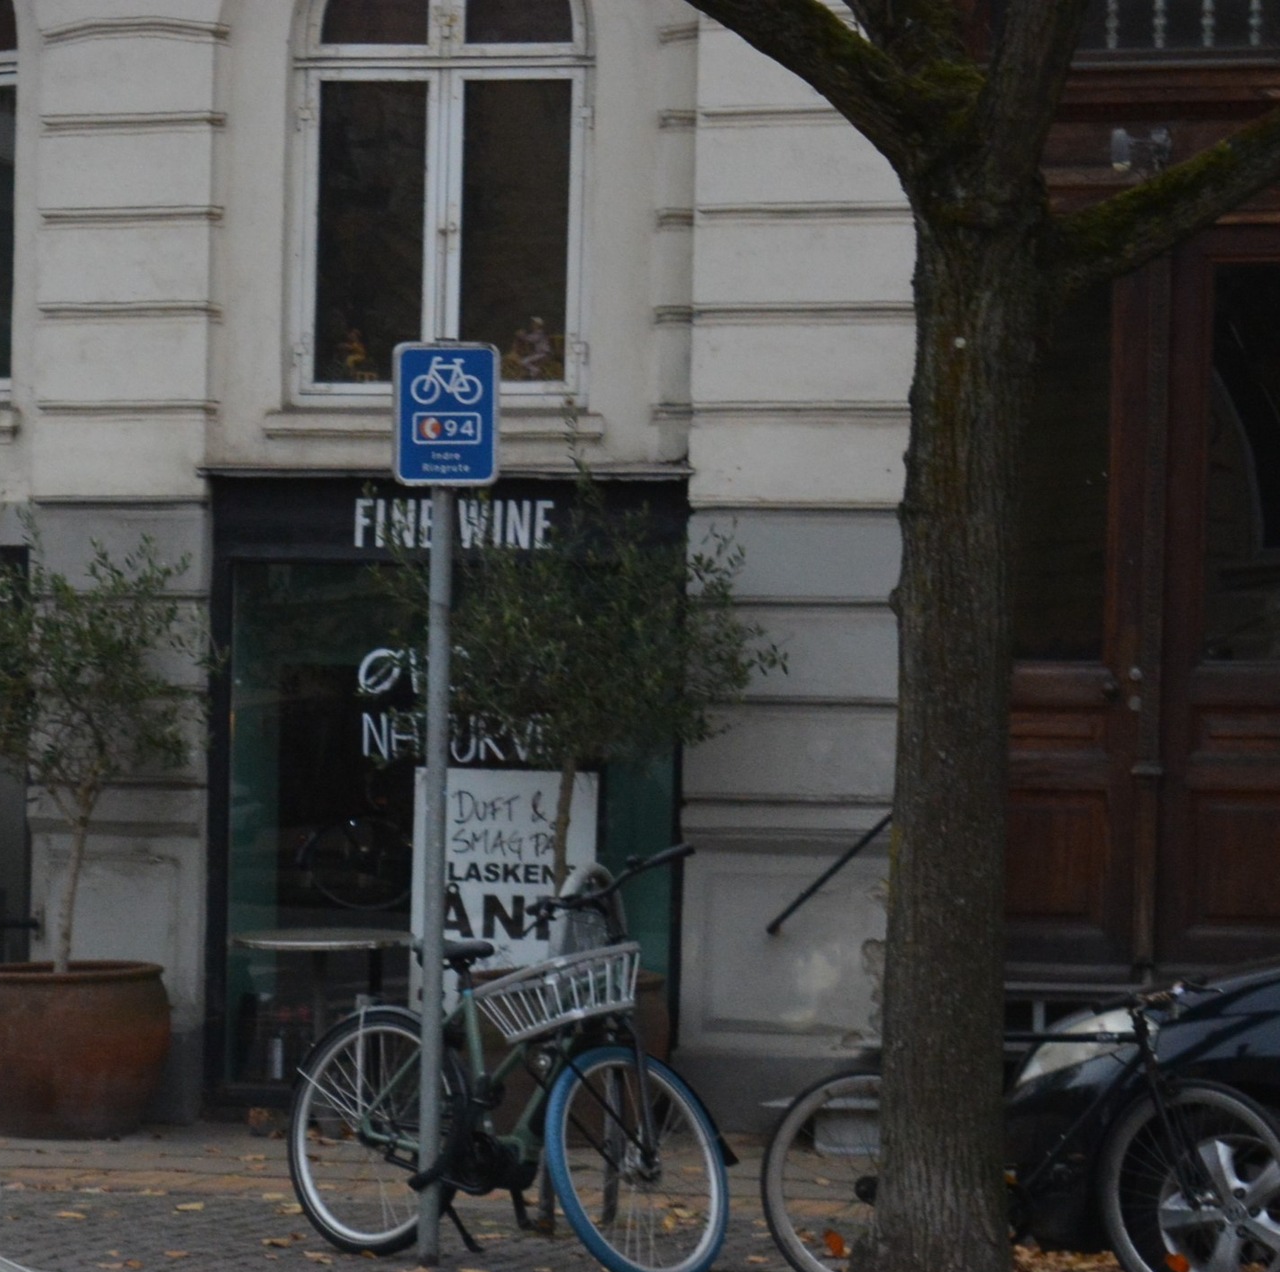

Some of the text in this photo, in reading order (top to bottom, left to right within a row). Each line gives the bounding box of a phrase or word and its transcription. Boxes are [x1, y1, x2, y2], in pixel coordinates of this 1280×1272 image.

[444, 419, 475, 437] 94
[431, 451, 461, 461] Indre
[421, 463, 471, 474] Ringrute
[458, 499, 555, 549] WINE
